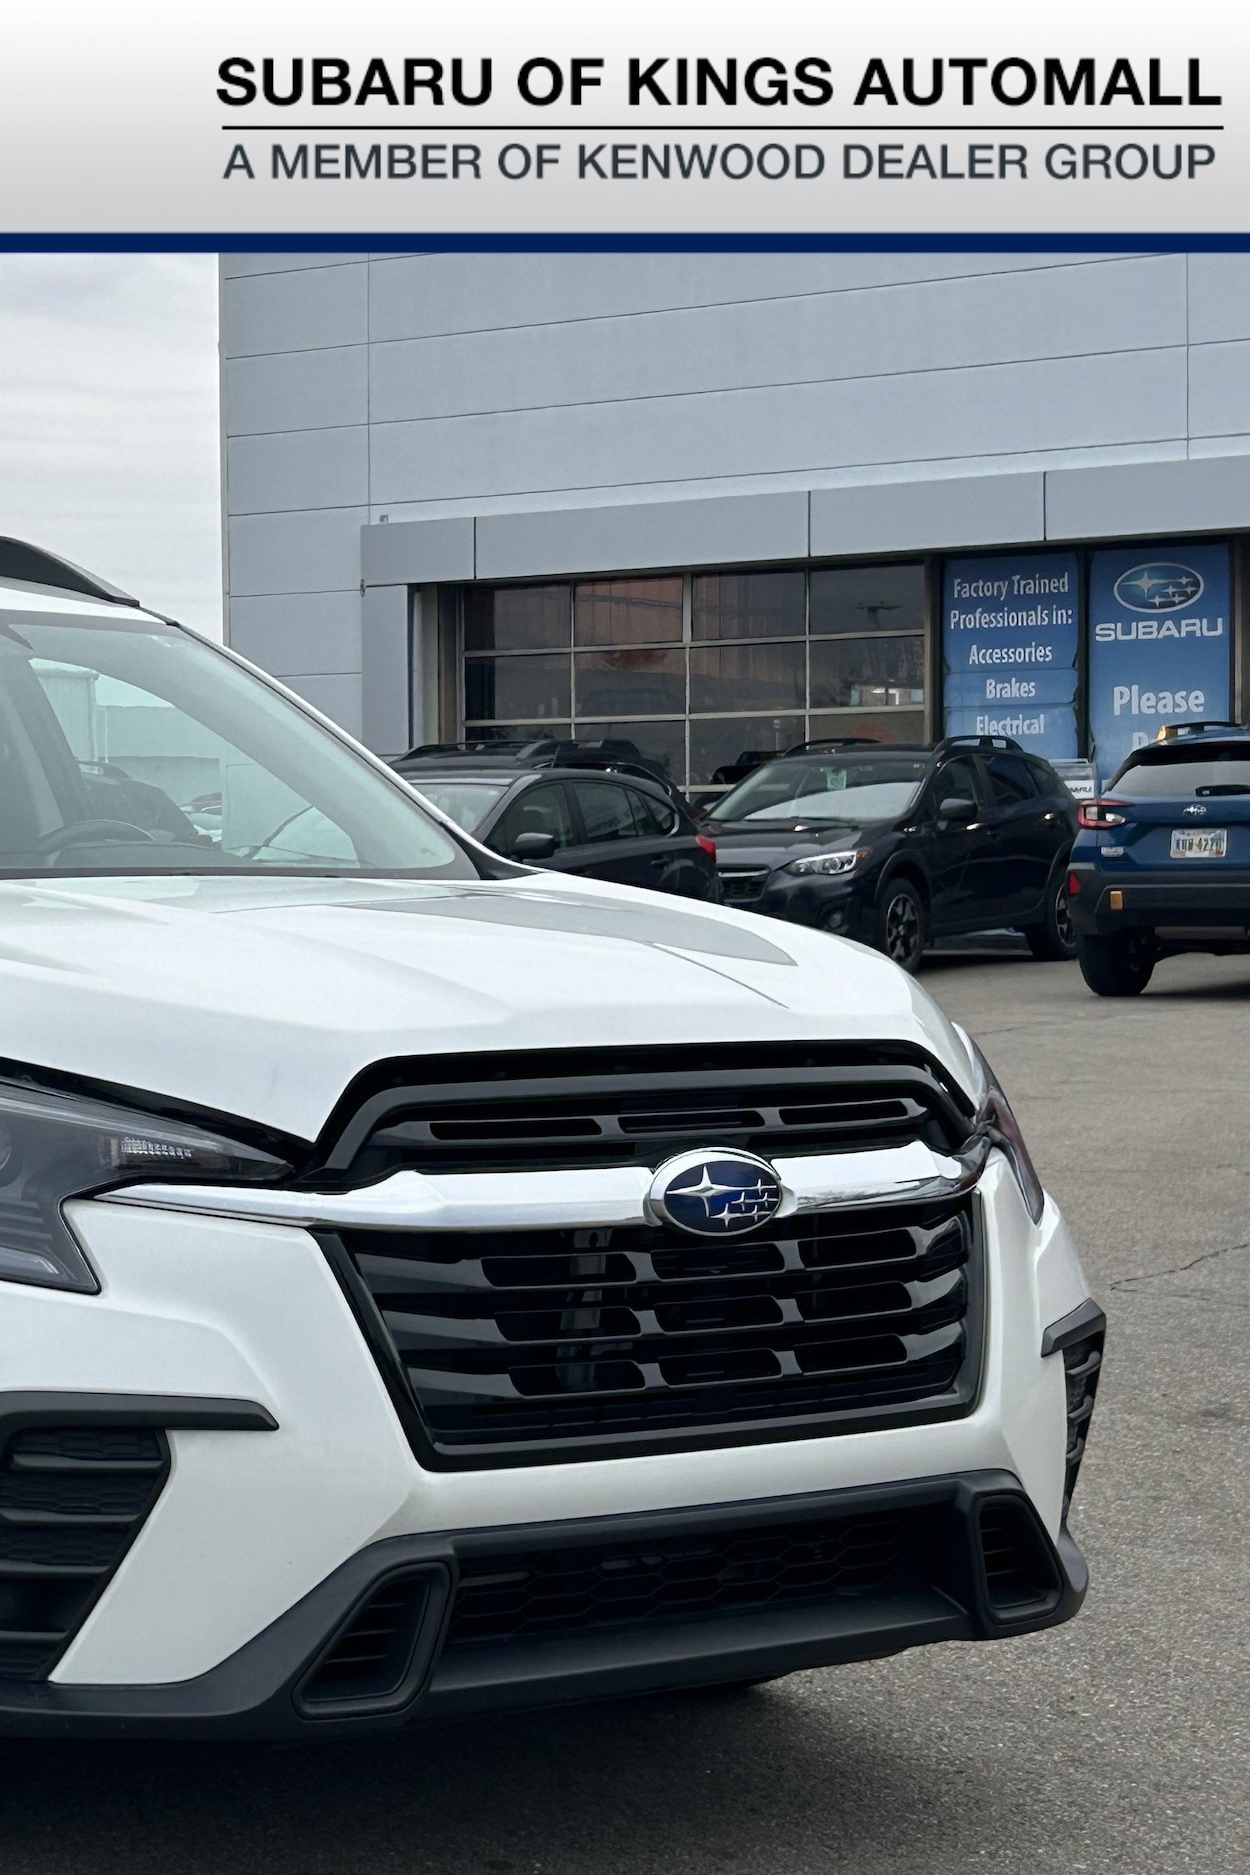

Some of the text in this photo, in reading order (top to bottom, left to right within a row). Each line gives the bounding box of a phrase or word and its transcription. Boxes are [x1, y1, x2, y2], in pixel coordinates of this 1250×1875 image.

[953, 572, 1069, 601] Factory Trained
[950, 604, 1073, 630] Professionals in:
[1095, 617, 1224, 642] SUBARU
[968, 641, 1053, 666] Accessories
[986, 676, 1036, 700] Brakes
[1113, 684, 1205, 716] Please
[976, 713, 1045, 736] Electrical
